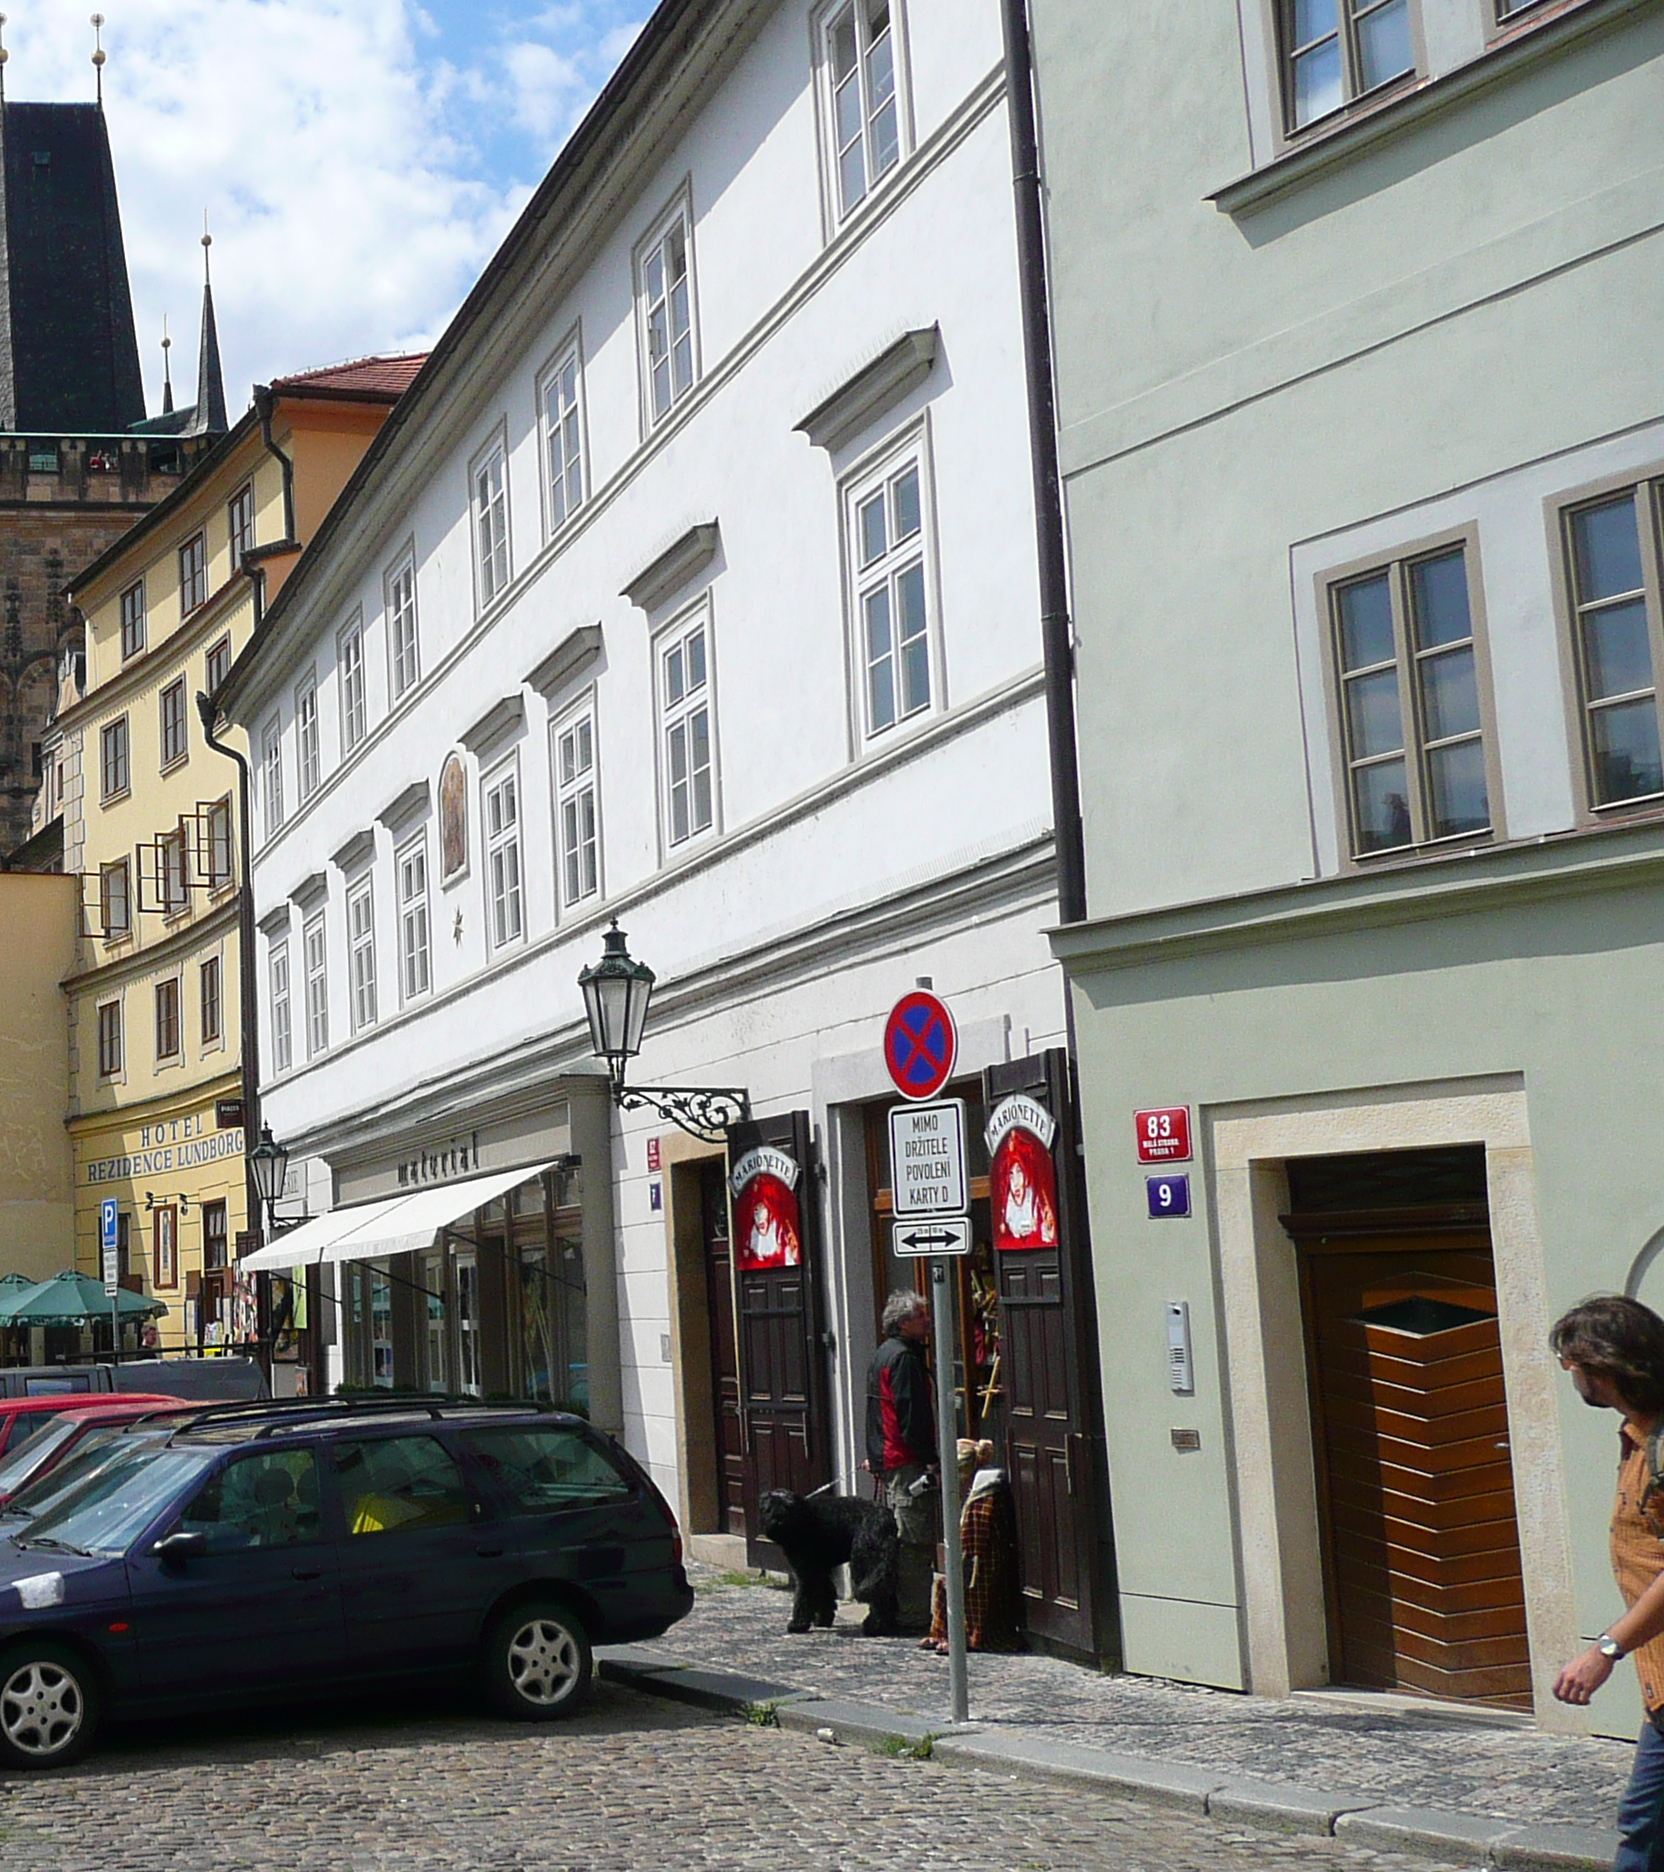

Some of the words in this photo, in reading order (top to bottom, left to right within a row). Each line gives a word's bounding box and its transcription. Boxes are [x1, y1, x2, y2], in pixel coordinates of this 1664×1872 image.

[141, 1114, 203, 1147] HOTEL
[912, 1114, 938, 1134] MIMO
[991, 1103, 1046, 1138] MARIONETTE
[1147, 1115, 1171, 1138] 83
[88, 1149, 172, 1182] REZIDENCE
[177, 1129, 243, 1167] LUNDBORG
[905, 1136, 948, 1158] DRŽITELE
[736, 1153, 791, 1187] MARIONETTE
[906, 1157, 950, 1181] POVOLENÍ
[910, 1187, 938, 1205] KARTY
[941, 1186, 949, 1203] D
[1159, 1184, 1172, 1207] 9
[104, 1205, 114, 1234] P
